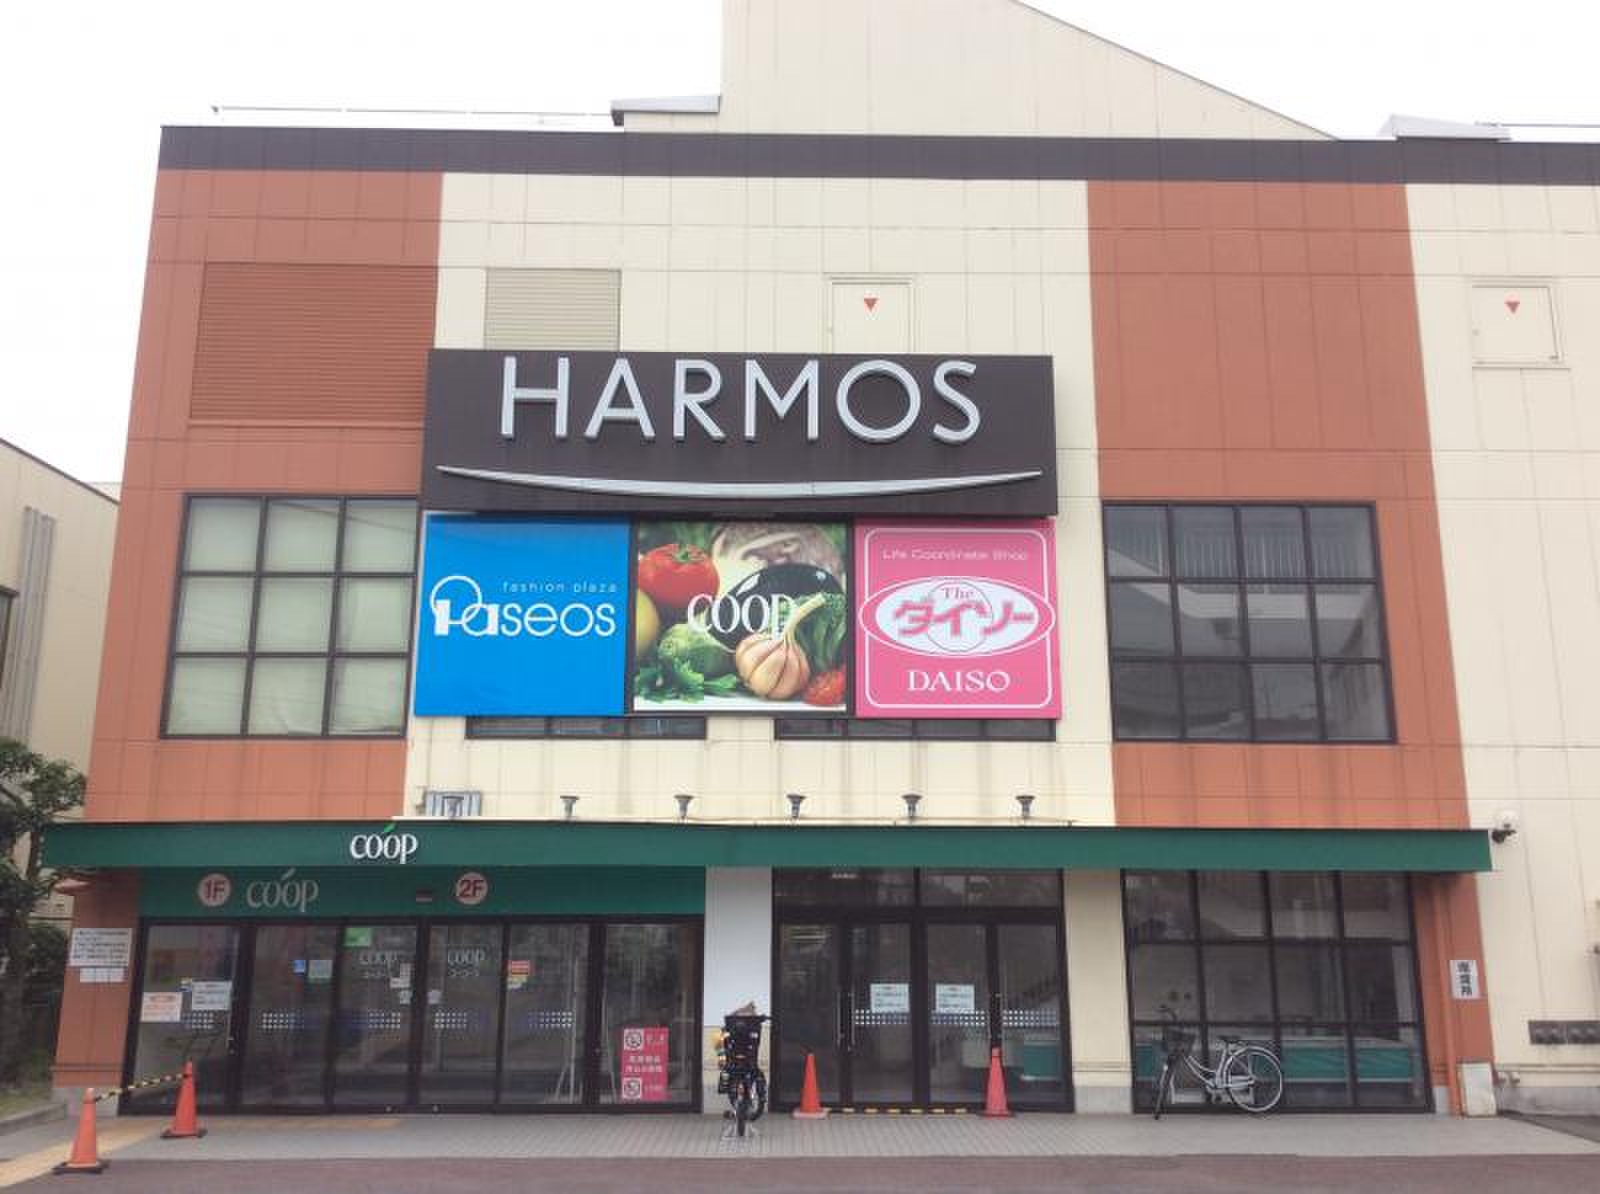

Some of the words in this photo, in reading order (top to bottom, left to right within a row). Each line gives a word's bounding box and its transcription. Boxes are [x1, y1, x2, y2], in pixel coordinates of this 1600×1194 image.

[500, 355, 982, 444] HARMOS
[502, 581, 565, 593] fashion
[573, 581, 618, 595] plaza
[942, 587, 975, 600] The
[430, 575, 617, 637] Paseos
[893, 597, 1037, 638] ダイソー
[907, 669, 1011, 693] DAISO
[204, 880, 226, 899] 1F
[459, 879, 484, 899] 2F
